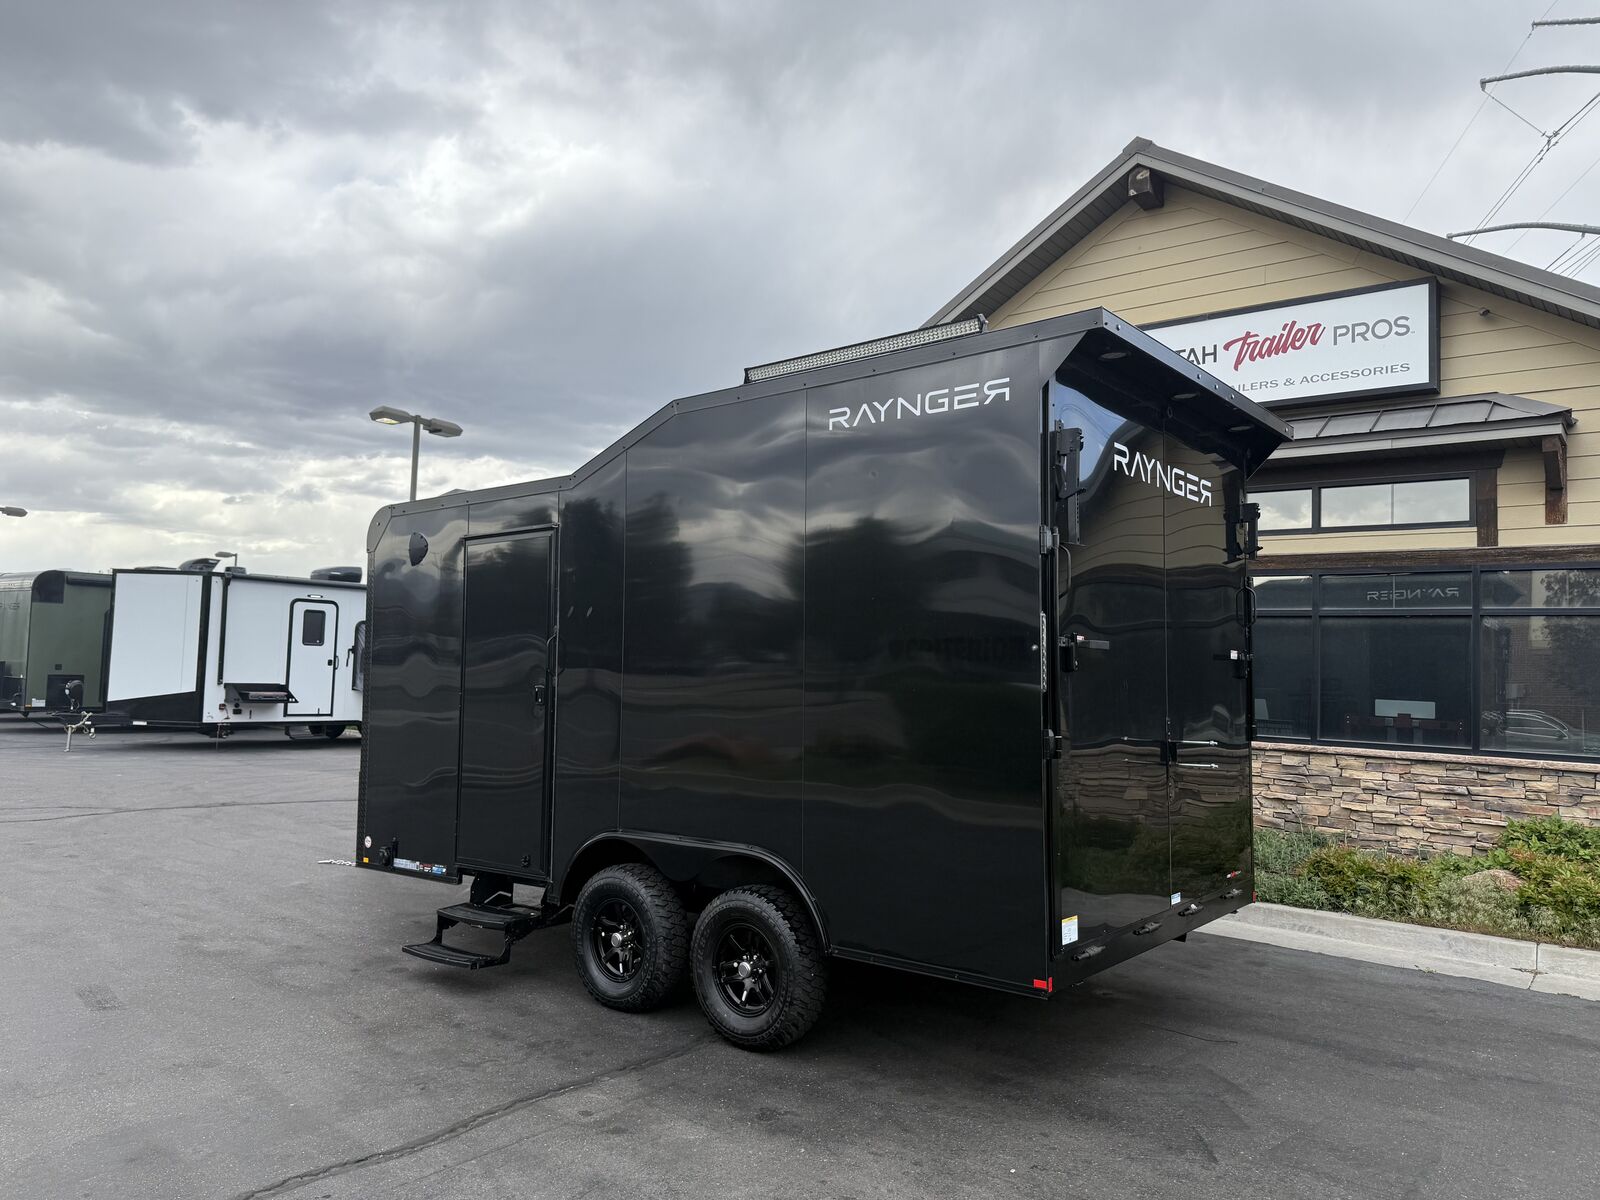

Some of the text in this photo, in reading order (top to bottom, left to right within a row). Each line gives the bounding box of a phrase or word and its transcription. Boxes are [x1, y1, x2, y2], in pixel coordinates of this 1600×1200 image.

[1174, 316, 1411, 371] TAH Trailer PROS
[1283, 377, 1296, 387] &
[1299, 363, 1410, 384] ACCESSORIES
[828, 377, 1011, 431] RAYNGER
[1113, 442, 1212, 507] RAYNGER
